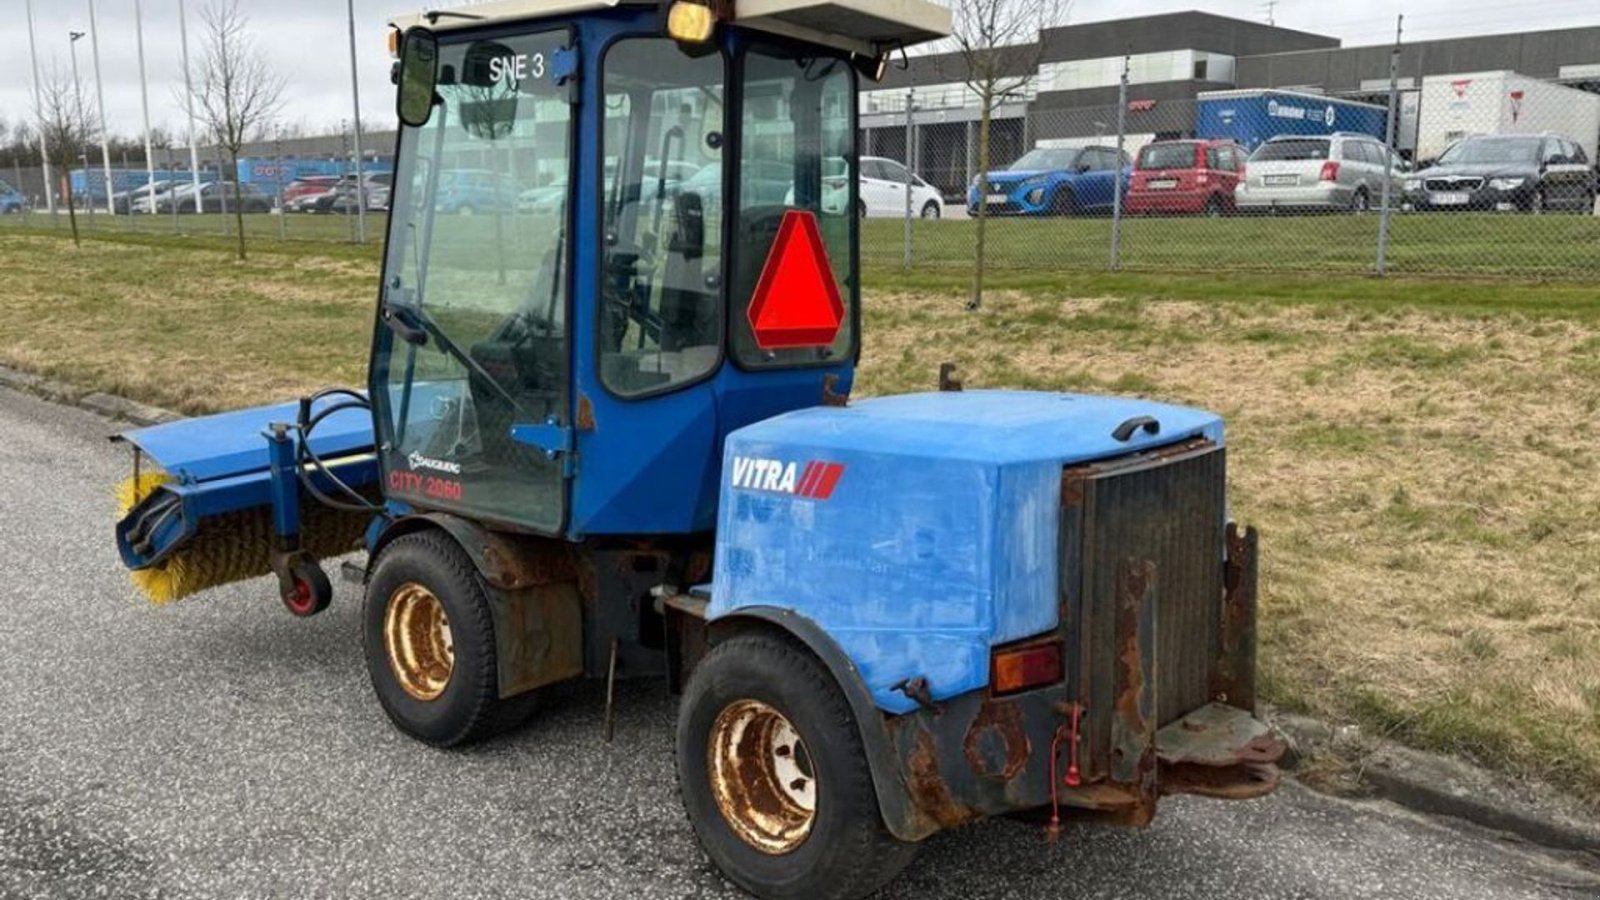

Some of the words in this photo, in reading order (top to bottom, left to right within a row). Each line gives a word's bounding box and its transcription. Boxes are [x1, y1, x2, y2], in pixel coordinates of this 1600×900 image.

[489, 55, 527, 81] SNE
[531, 52, 545, 79] 3
[389, 470, 423, 498] CITY
[426, 476, 464, 499] 2060
[732, 456, 797, 493] VITRA
